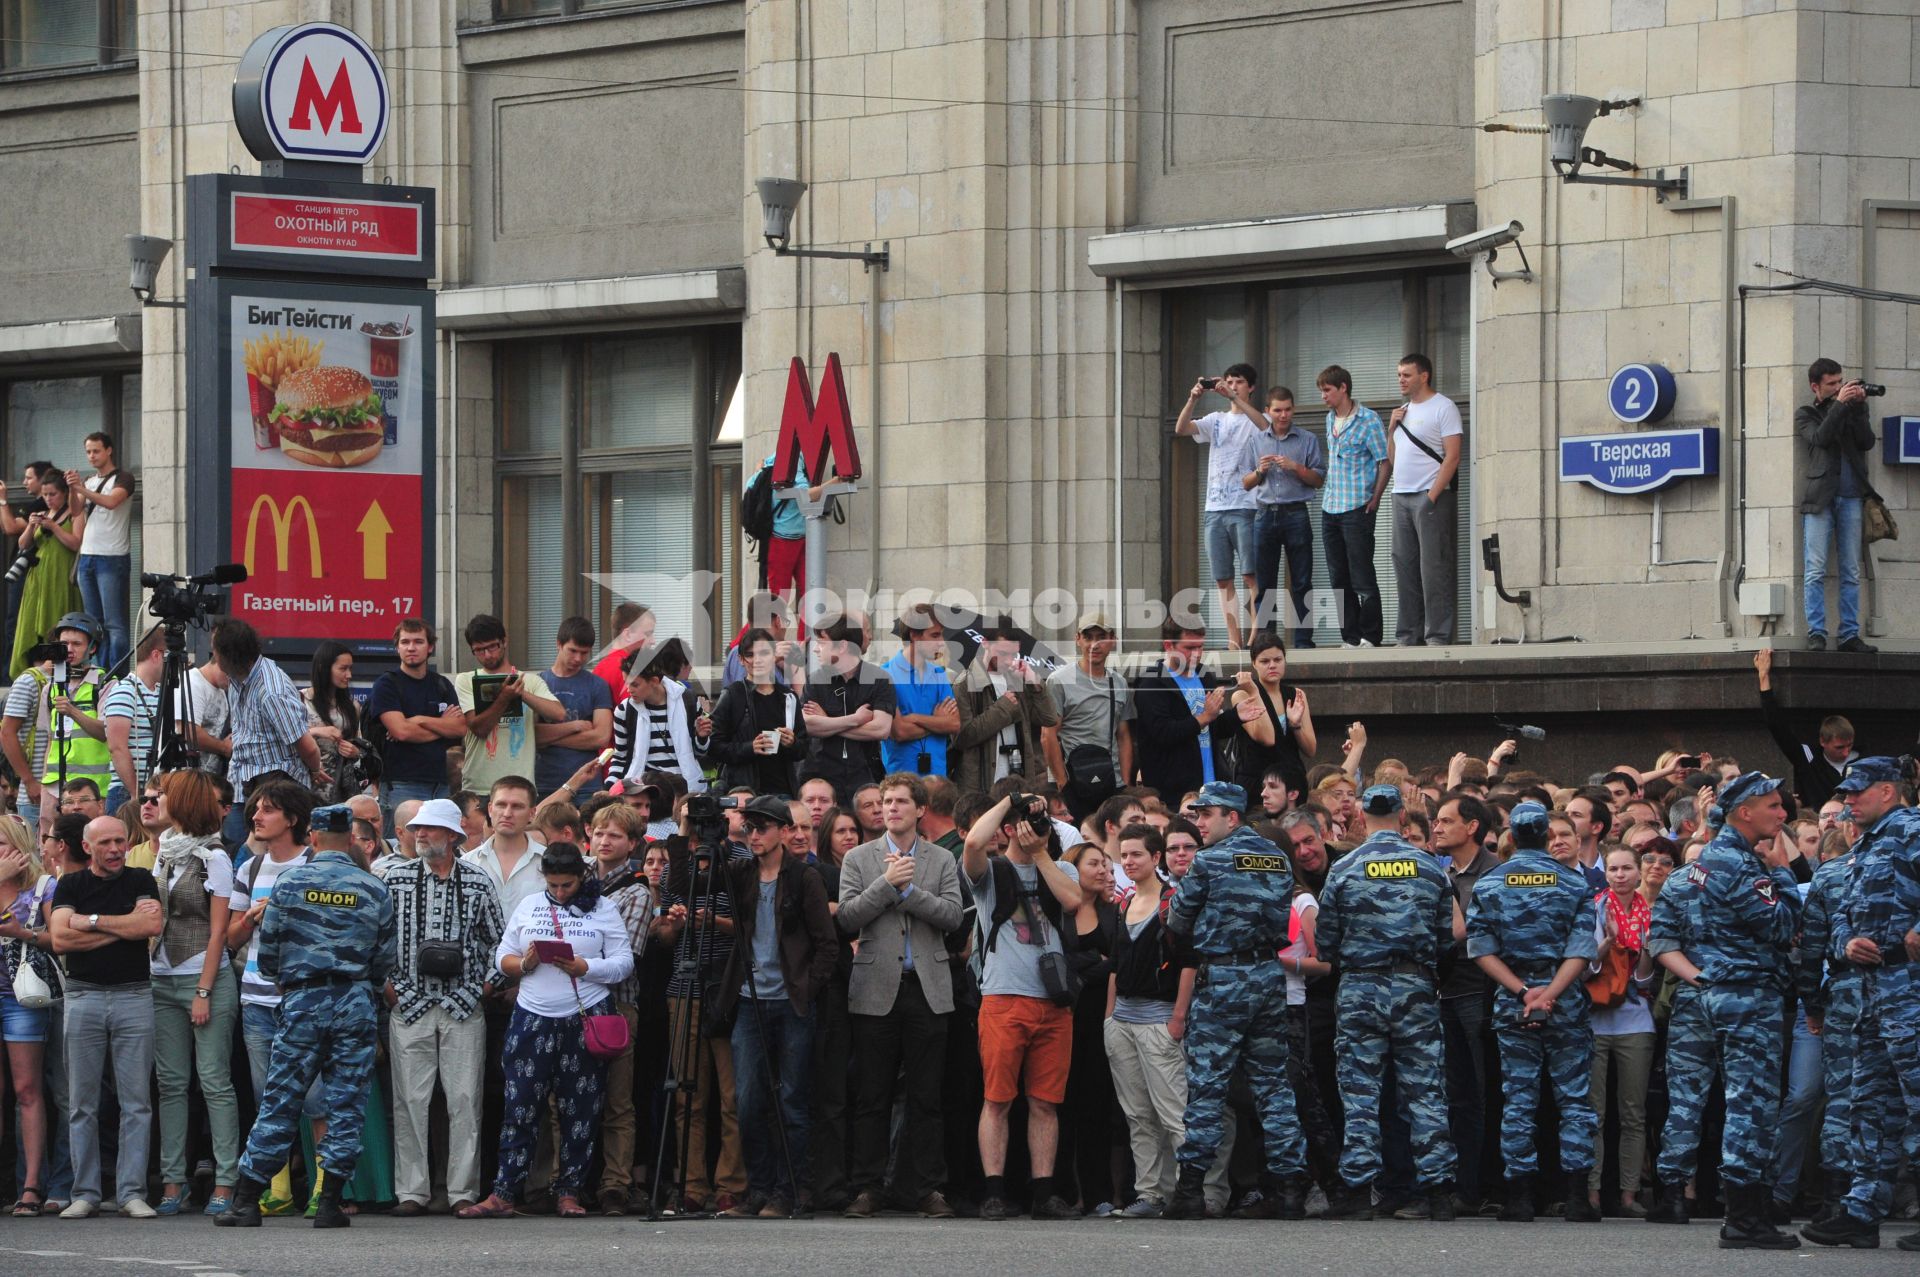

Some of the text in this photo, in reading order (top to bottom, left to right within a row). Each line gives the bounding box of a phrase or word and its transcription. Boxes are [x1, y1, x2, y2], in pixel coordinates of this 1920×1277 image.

[288, 54, 362, 136] М
[295, 204, 359, 216] СТАНЦИЯ МЕТРО
[274, 215, 379, 238] ОХОТНЫЙ РЯД
[296, 235, 357, 247] OKHOTNY RYAD
[247, 305, 352, 330] БигТейсти
[1625, 377, 1641, 410] 2
[1590, 441, 1671, 465] Тверская
[1609, 462, 1651, 483] улица
[243, 593, 414, 617] Газетный пер., 17
[1241, 856, 1282, 869] ОМОН
[1367, 861, 1416, 878] ОМОН
[1507, 874, 1556, 886] ОМОН
[307, 890, 355, 905] ОМОН
[524, 928, 596, 939] ПРОТИ МЕНЯ
